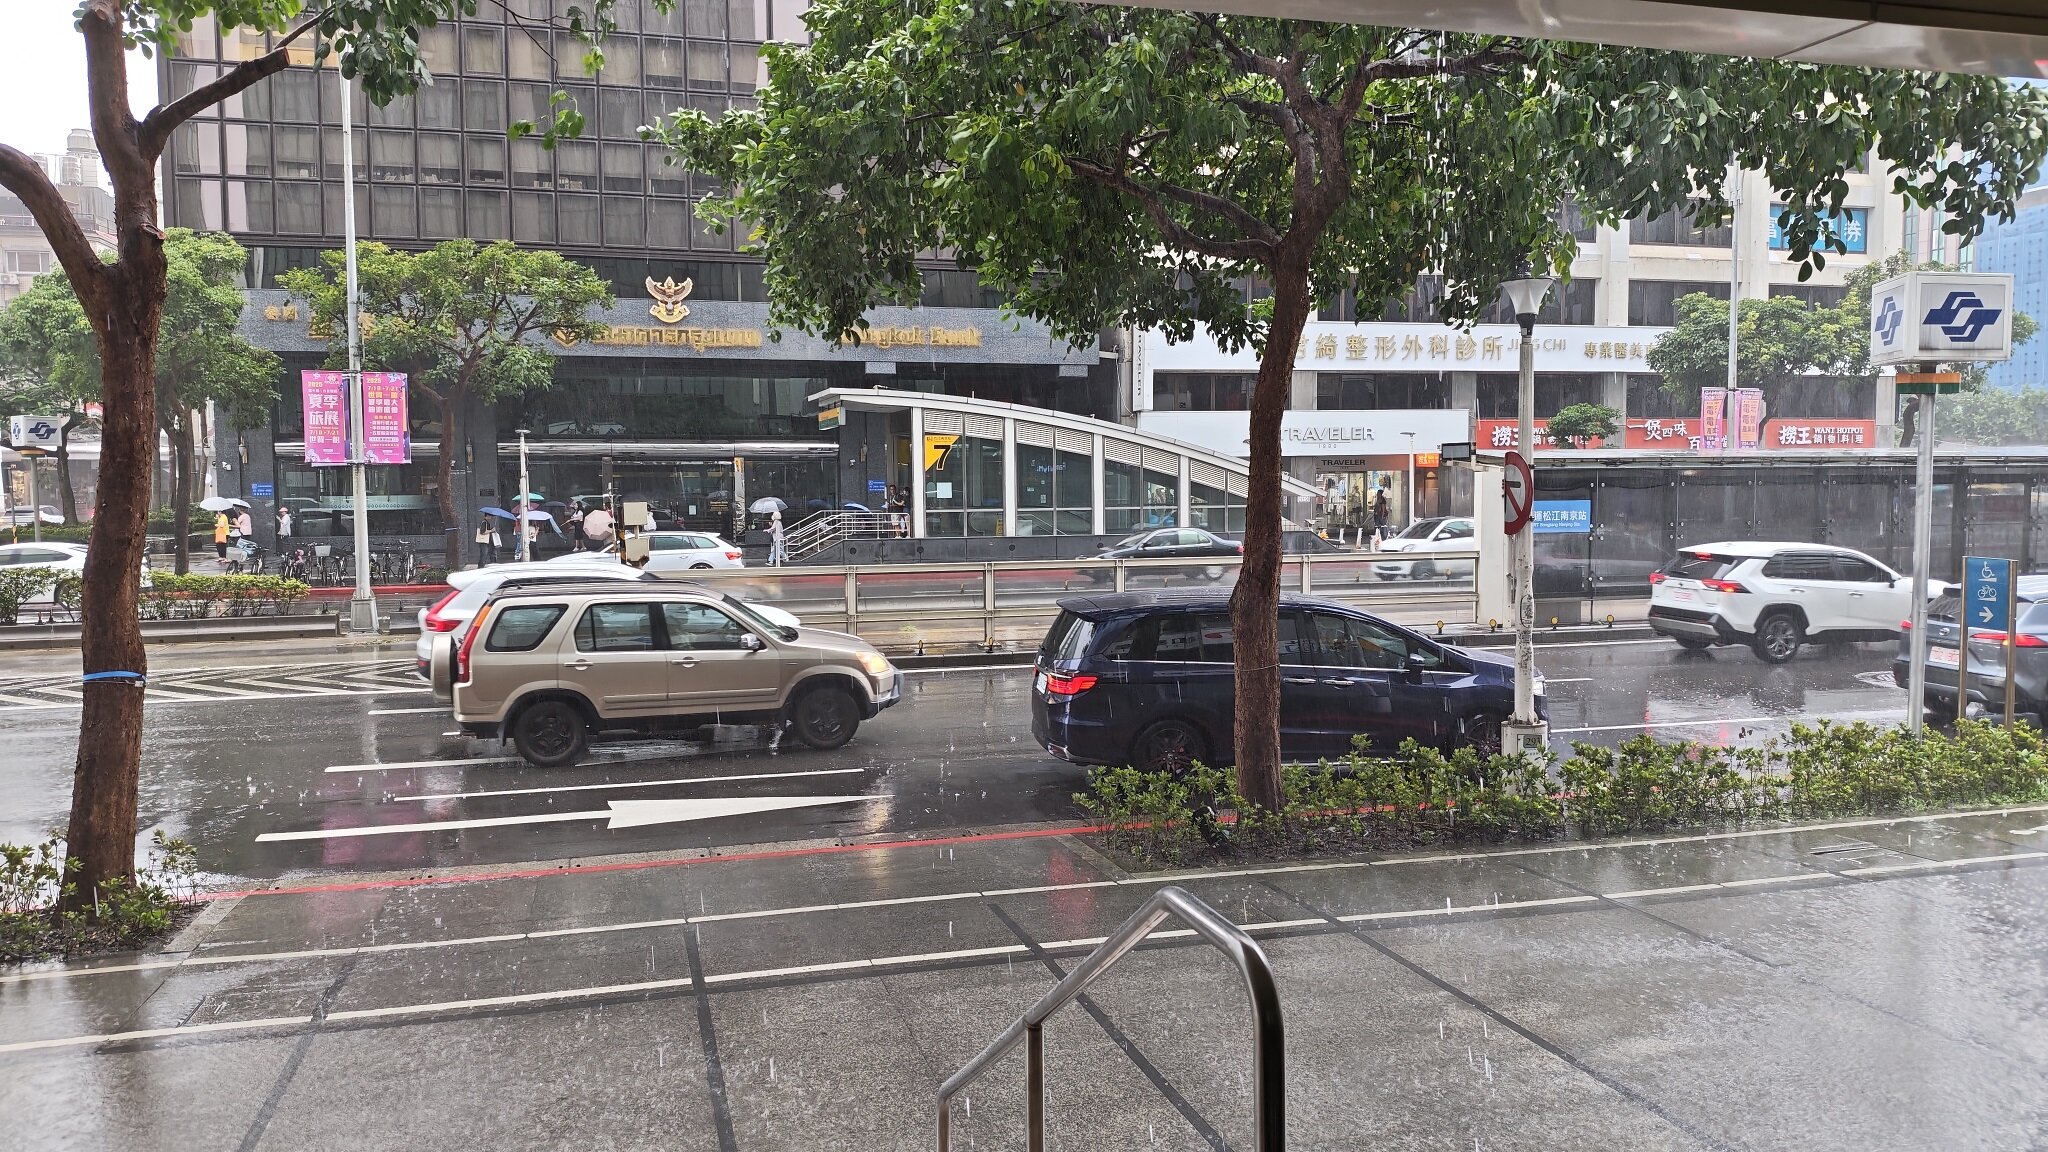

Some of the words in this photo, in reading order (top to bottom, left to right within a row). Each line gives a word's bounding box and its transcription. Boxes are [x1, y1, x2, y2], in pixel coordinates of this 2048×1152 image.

[1507, 338, 1540, 351] JIG
[1543, 338, 1567, 351] CHI
[308, 394, 339, 409] 夏季
[308, 410, 340, 425] 旅展
[933, 444, 953, 471] 7
[1533, 510, 1587, 521] 運松江南京站
